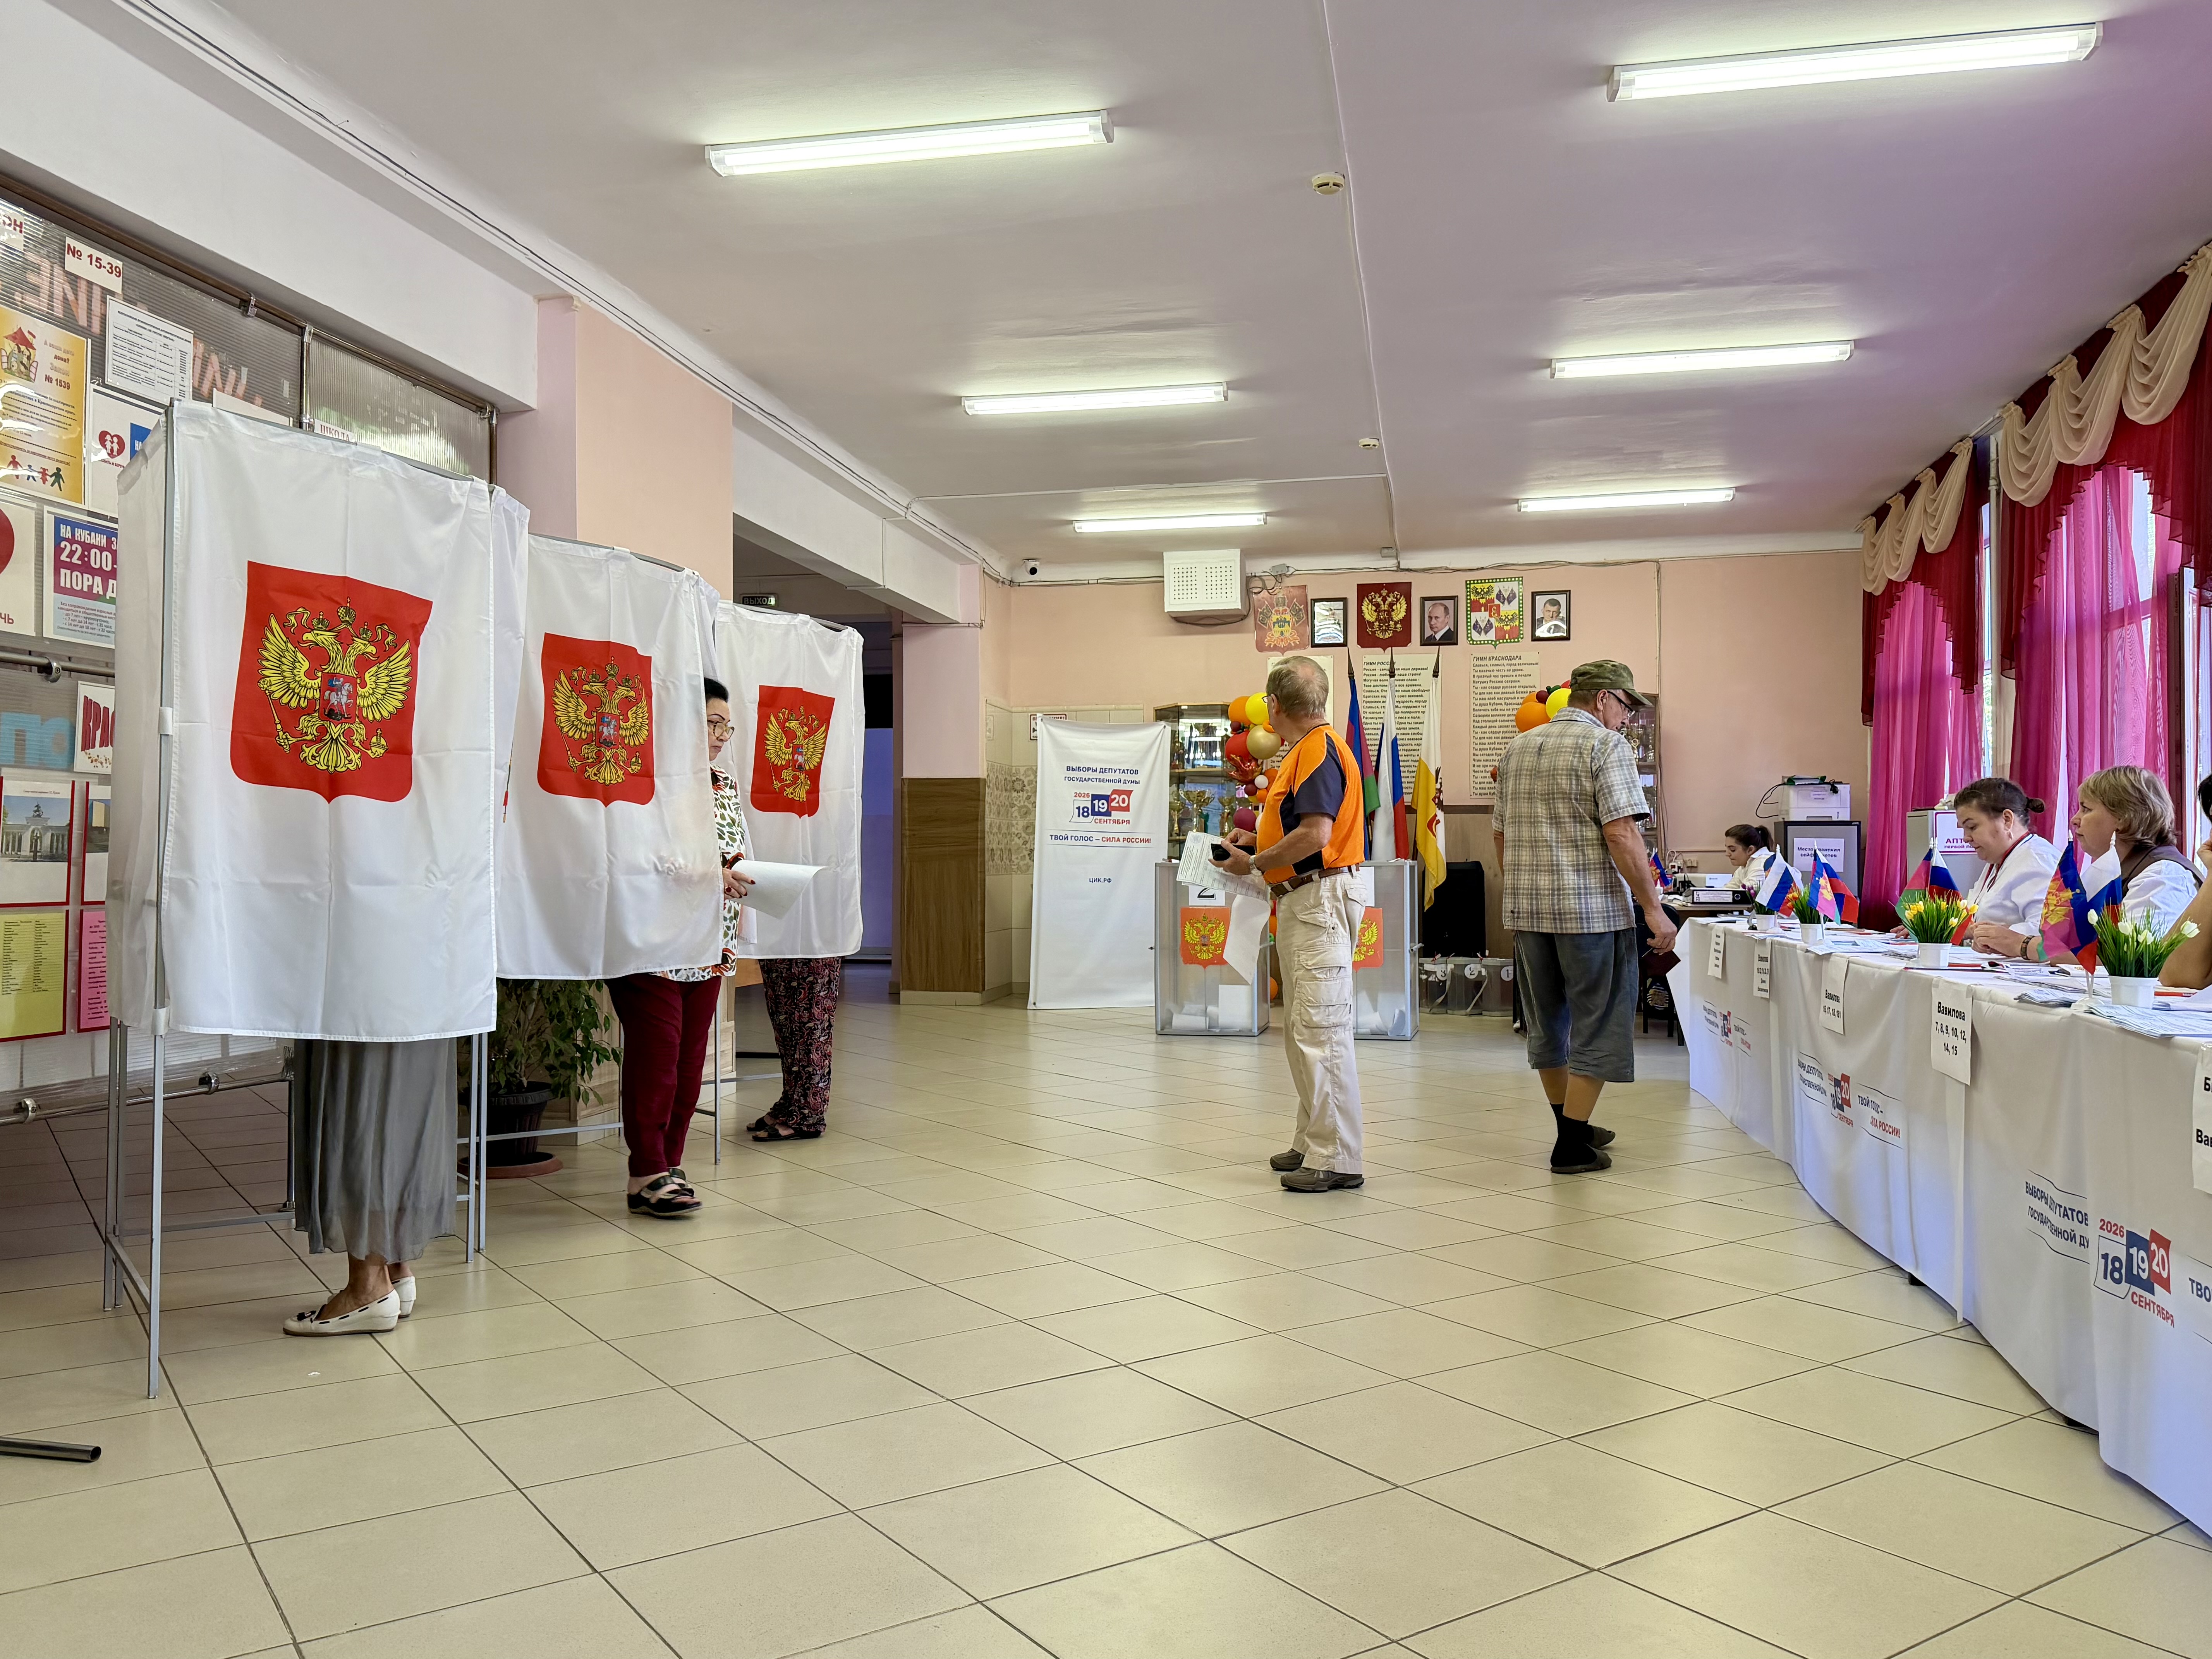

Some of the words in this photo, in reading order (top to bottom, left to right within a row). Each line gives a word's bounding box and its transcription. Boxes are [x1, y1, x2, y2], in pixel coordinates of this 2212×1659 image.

[67, 243, 82, 260] №
[87, 254, 121, 278] 15-39
[54, 354, 69, 364] дома?
[45, 374, 53, 384] №
[55, 378, 70, 390] 1539
[320, 424, 349, 441] ШКОЛА
[60, 524, 72, 539] НА
[75, 527, 106, 548] КУБАНИ
[112, 537, 117, 550] З
[60, 568, 103, 595] ПОРА
[1076, 806, 1090, 817] 18
[1093, 800, 1108, 812] 19
[1111, 795, 1128, 807] 20
[1937, 1001, 1965, 1021] Вавилова
[1936, 1022, 1939, 1033] 7,
[1940, 1023, 1944, 1035] 8,
[1946, 1025, 1949, 1037] 9,
[1952, 1045, 1957, 1056] 15
[1835, 1086, 1841, 1104] 19
[1841, 1081, 1849, 1100] 20
[1858, 1095, 1870, 1108] ТВОЙ
[1879, 1120, 1900, 1139] РОССИИ!
[2026, 1181, 2048, 1206] ВЫБОРЫ
[2099, 1218, 2124, 1238] 2026
[2101, 1252, 2123, 1285] 18
[2130, 1247, 2148, 1279] 19
[2151, 1242, 2168, 1278] 20
[2188, 1277, 2212, 1303] ТВО
[2131, 1291, 2174, 1328] СЕНТЯБРЯ
